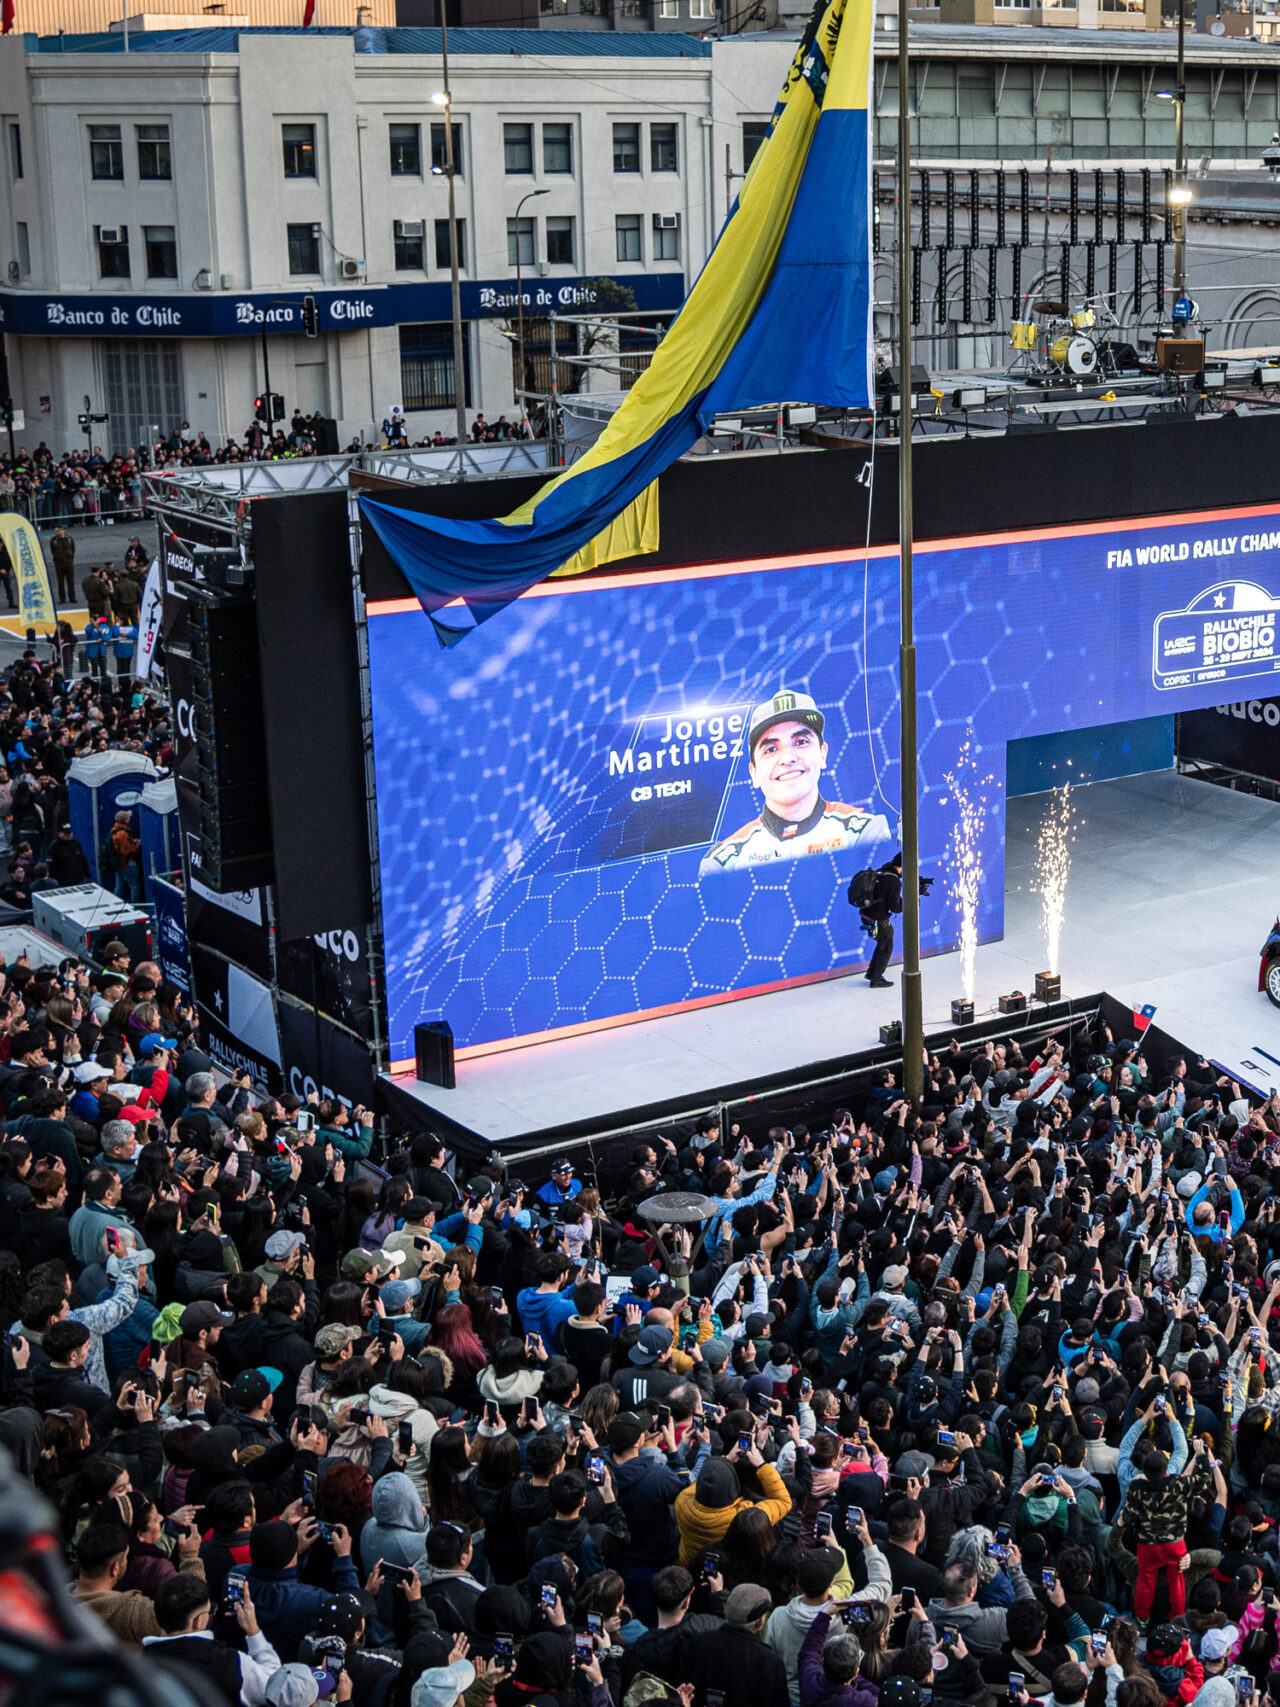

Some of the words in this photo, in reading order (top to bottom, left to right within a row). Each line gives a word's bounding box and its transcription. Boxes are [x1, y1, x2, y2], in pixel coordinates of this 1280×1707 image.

[330, 300, 374, 320] Chile
[479, 288, 531, 308] Banco
[536, 289, 552, 305] de
[46, 302, 104, 325] Banco
[111, 306, 128, 325] de
[136, 304, 182, 327] Chile
[236, 302, 293, 323] Banco
[1107, 549, 1133, 569] FIA
[1136, 542, 1189, 565] WORLD
[1193, 536, 1238, 559] RALLY
[1204, 612, 1276, 636] RALLYCHILE
[1163, 674, 1191, 687] COPEC
[1198, 670, 1226, 681] arauco
[660, 714, 744, 744] Jorge
[608, 737, 744, 776] Martínez
[631, 786, 652, 802] CB
[655, 780, 692, 798] TECH
[209, 1033, 268, 1084] RALLYCHILE
